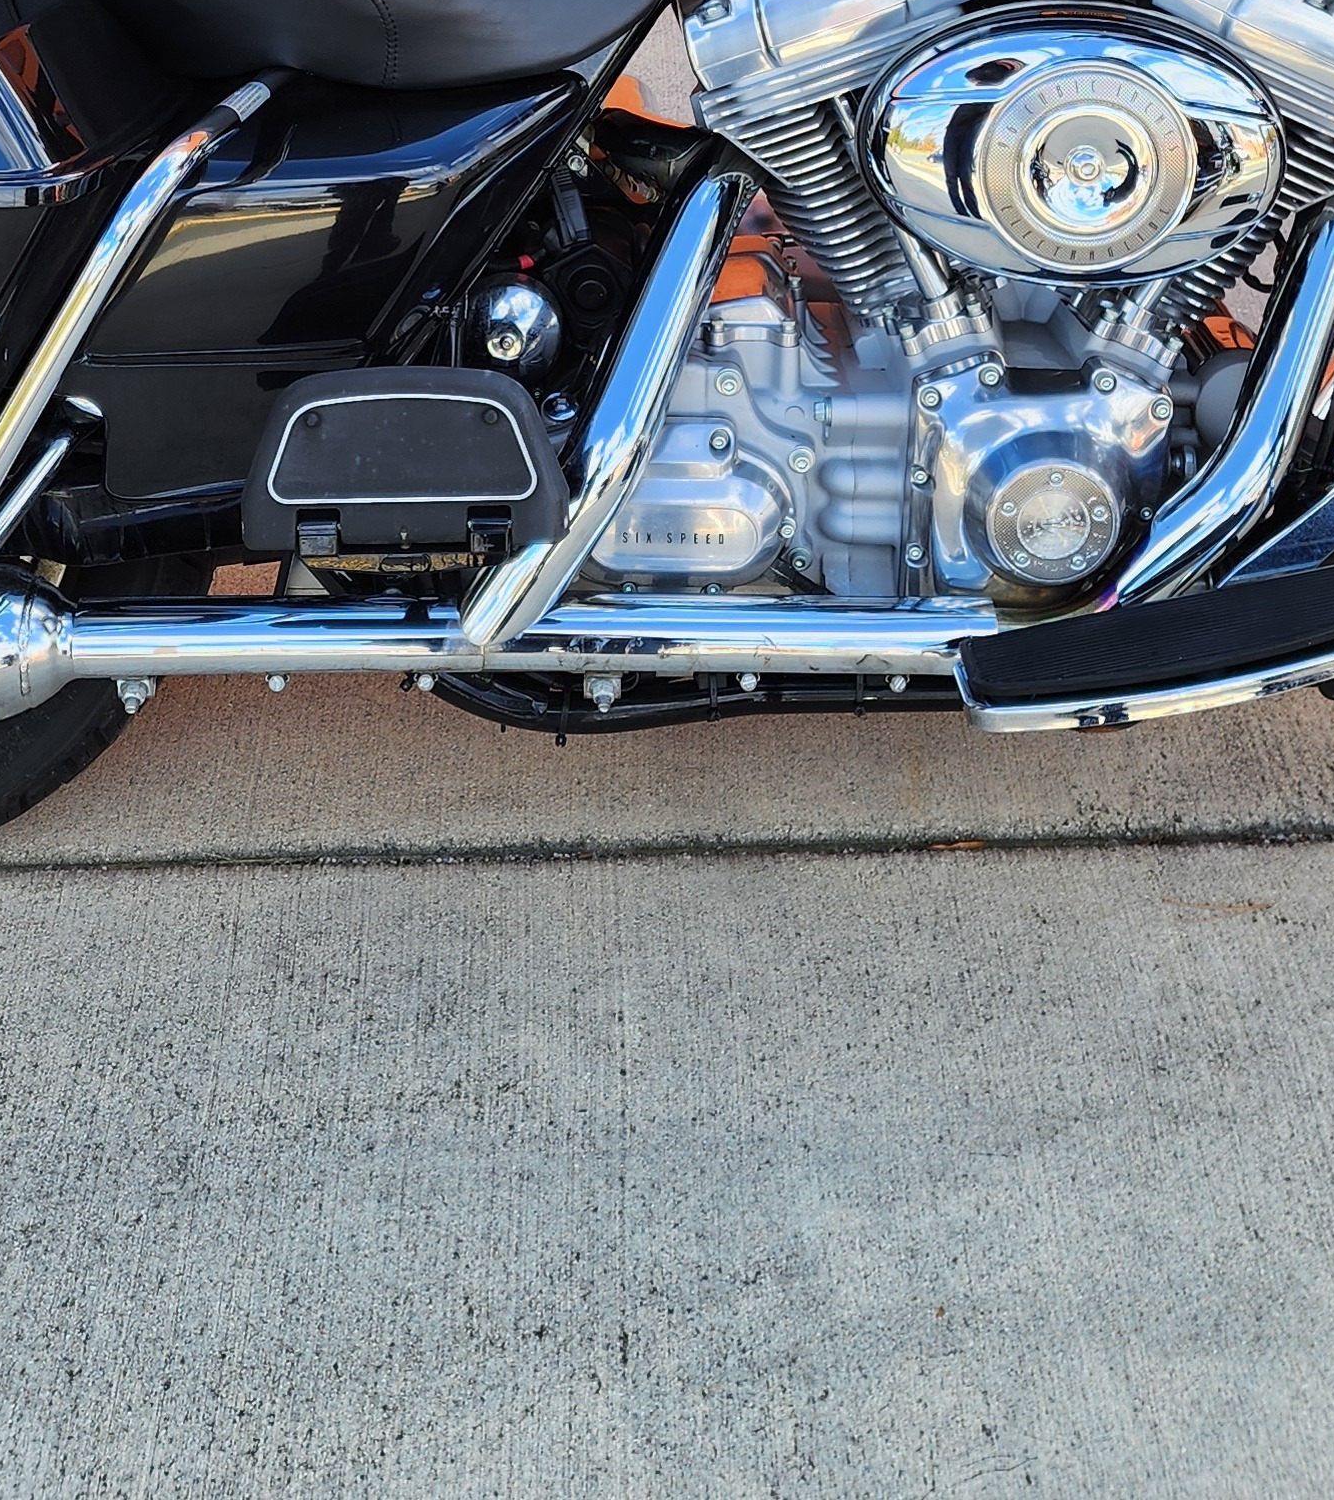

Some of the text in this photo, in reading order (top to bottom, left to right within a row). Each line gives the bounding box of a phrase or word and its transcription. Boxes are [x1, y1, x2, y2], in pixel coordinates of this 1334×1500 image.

[1024, 79, 1096, 114] CUBIC
[1116, 83, 1181, 152] INCHES
[622, 531, 725, 545] SIX SPEED
